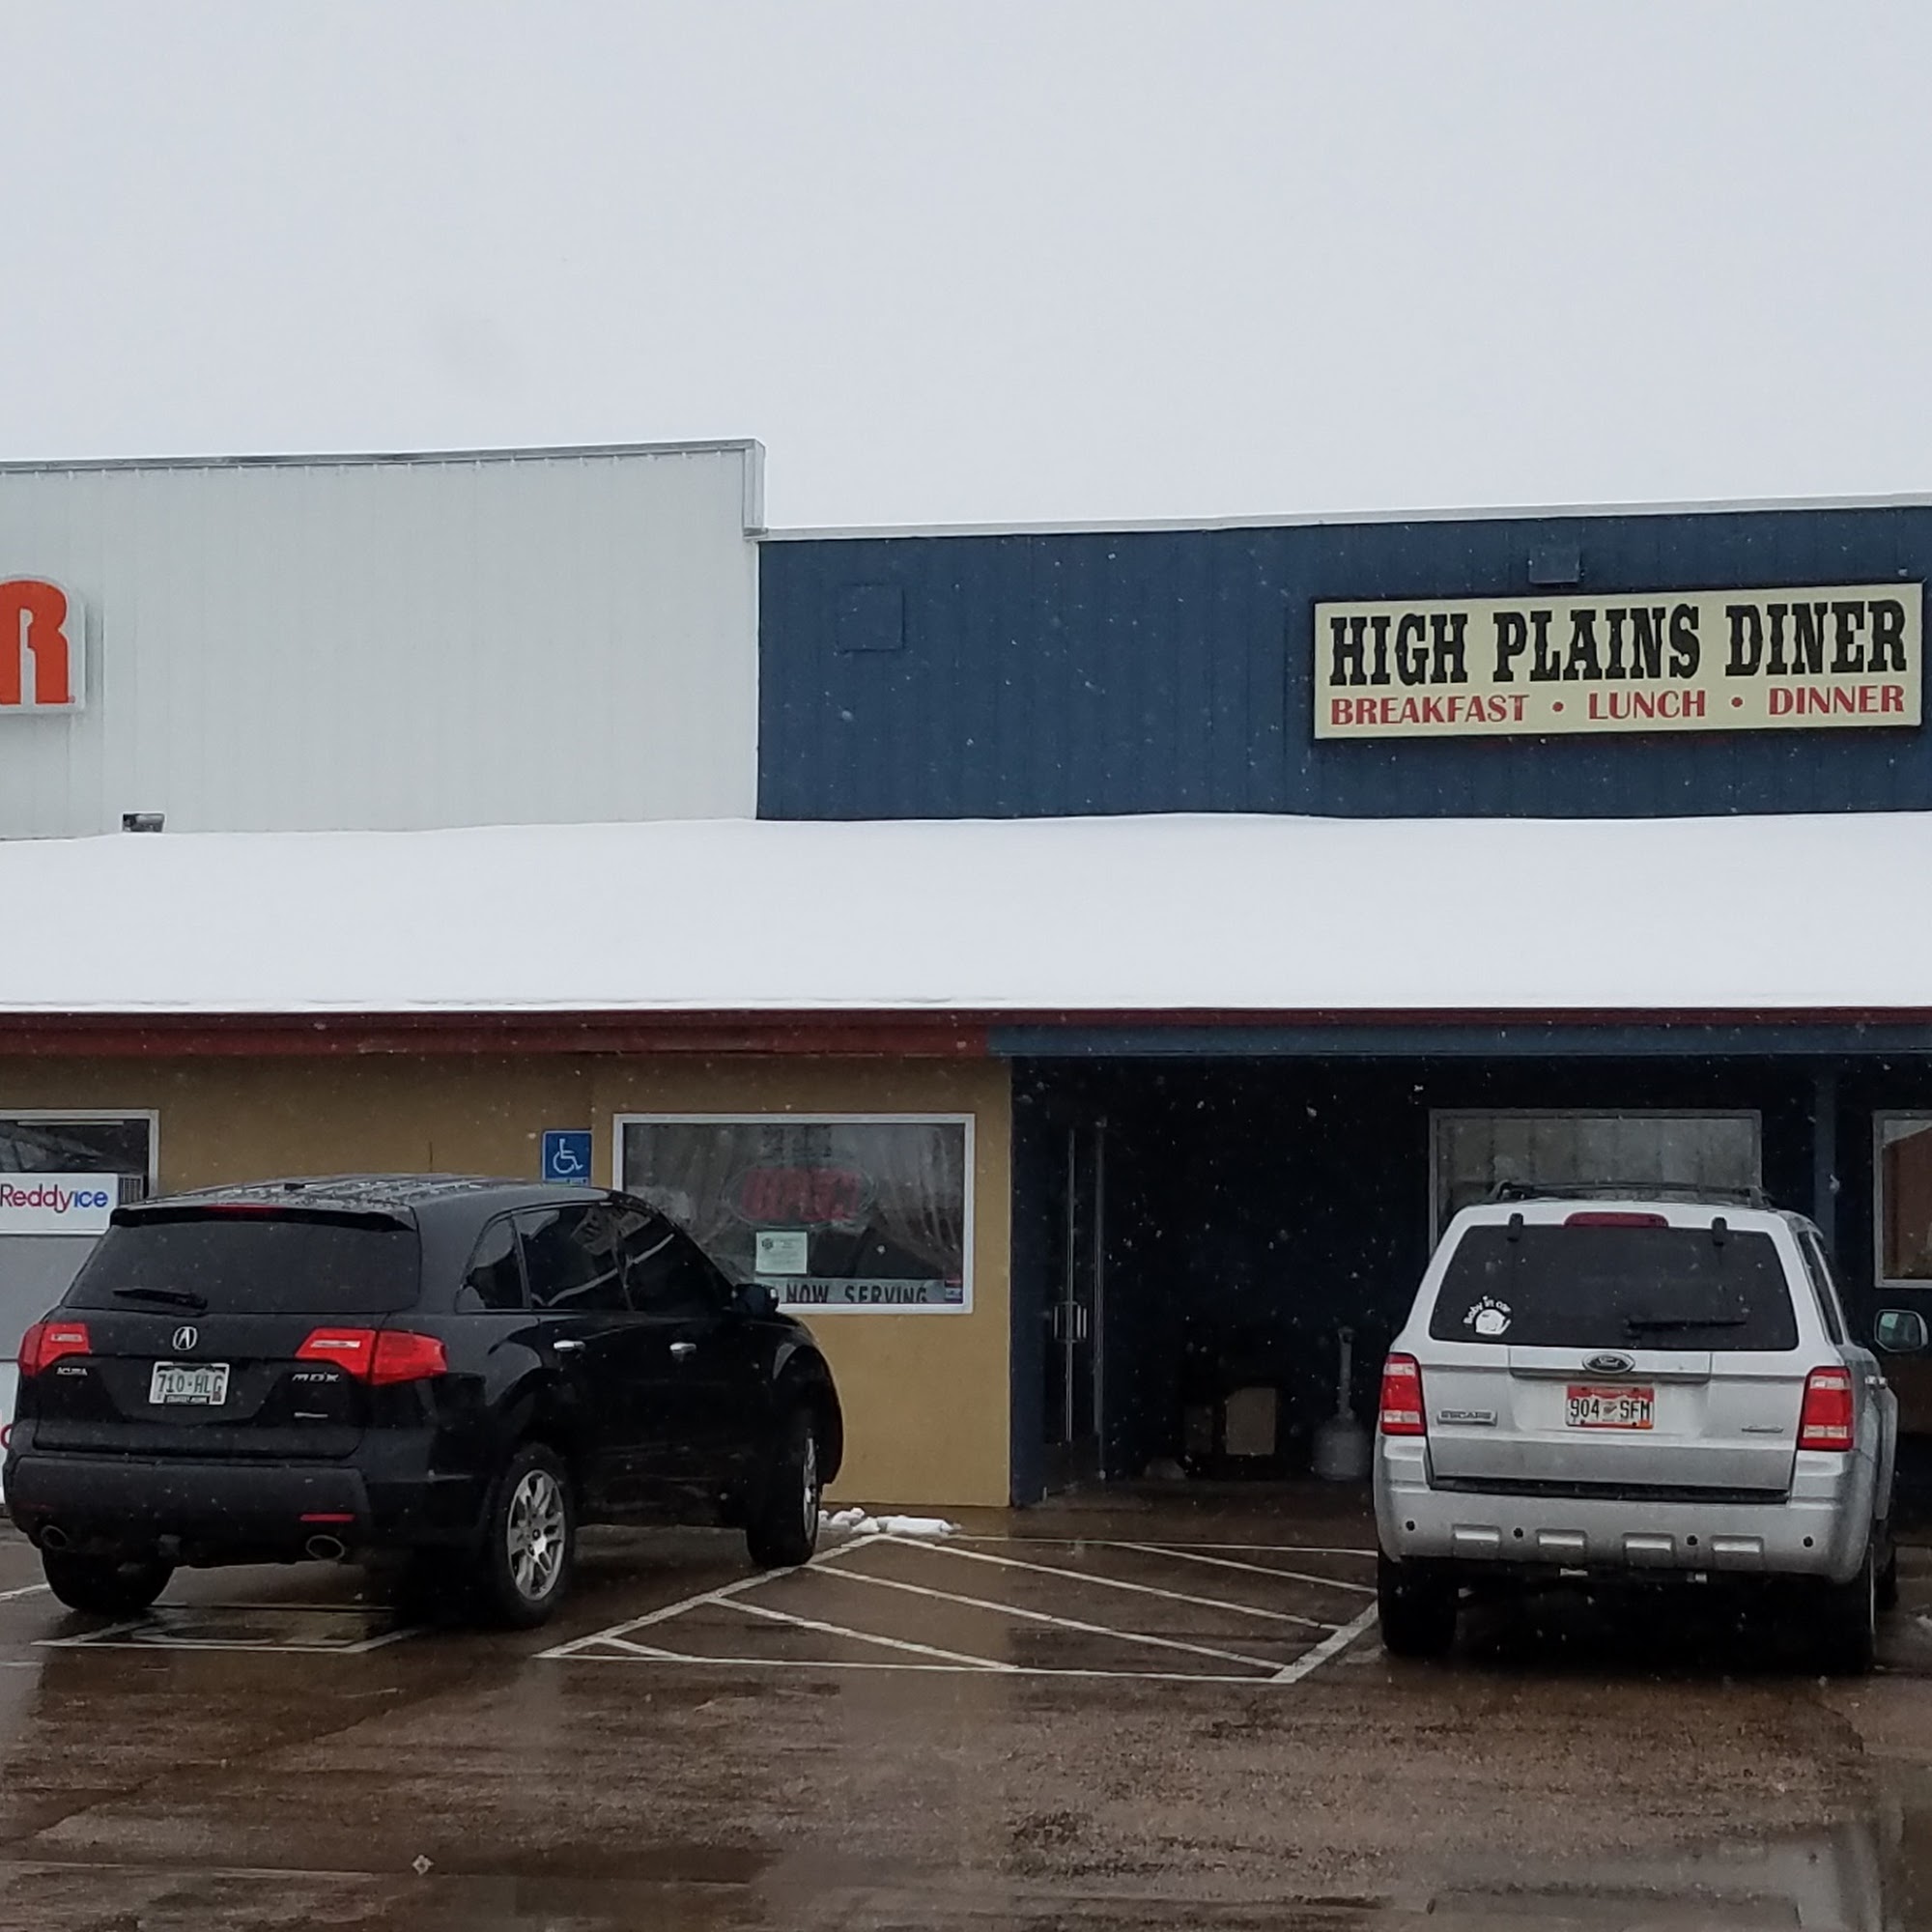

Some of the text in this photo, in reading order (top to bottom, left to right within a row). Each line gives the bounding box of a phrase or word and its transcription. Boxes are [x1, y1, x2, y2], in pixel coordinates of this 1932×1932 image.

[1329, 599, 1907, 687] HIGH PLAINS DINER
[1331, 684, 1905, 725] BREAKFAST LUNCH DINNER
[785, 1283, 927, 1303] NOW SERVING
[1570, 1398, 1600, 1419] 904
